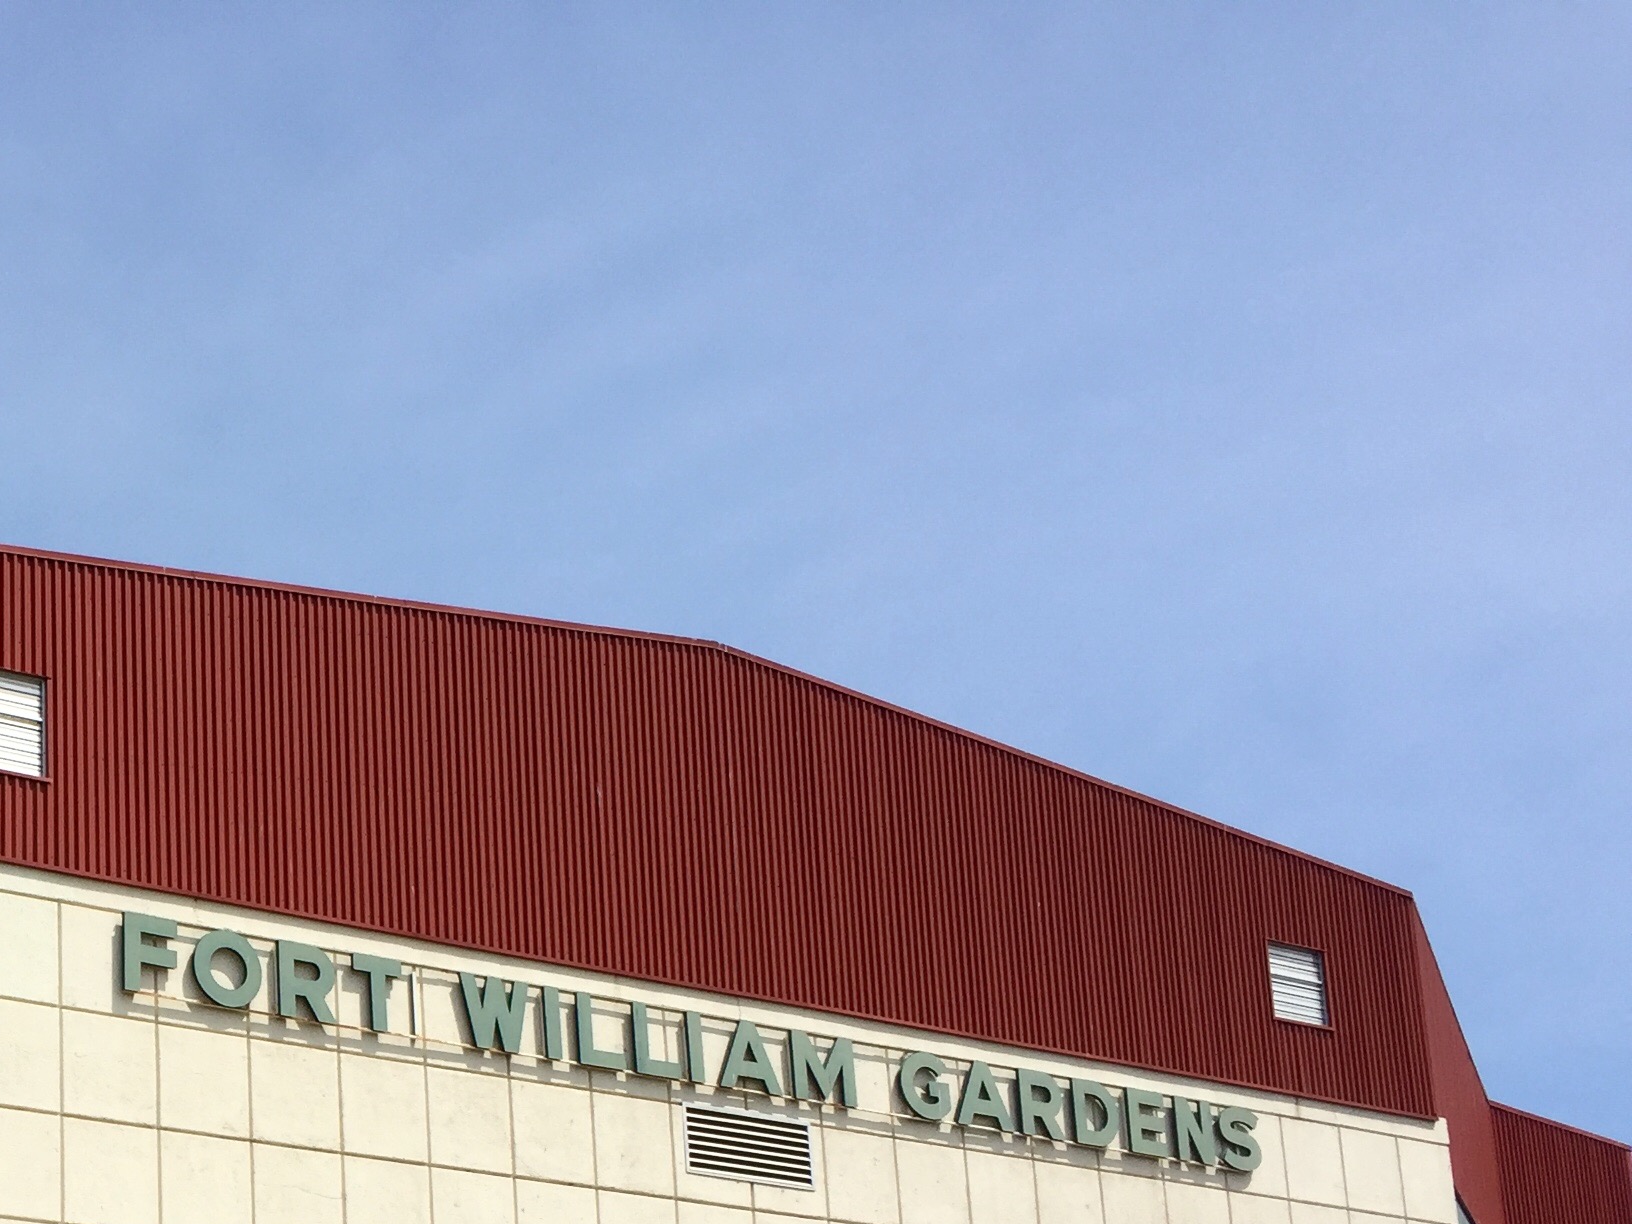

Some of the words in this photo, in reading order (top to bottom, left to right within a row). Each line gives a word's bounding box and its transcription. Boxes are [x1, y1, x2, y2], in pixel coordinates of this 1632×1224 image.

[121, 910, 402, 1032] FORT
[458, 970, 858, 1108] WILLIAM
[898, 1051, 1263, 1172] GARDENS
